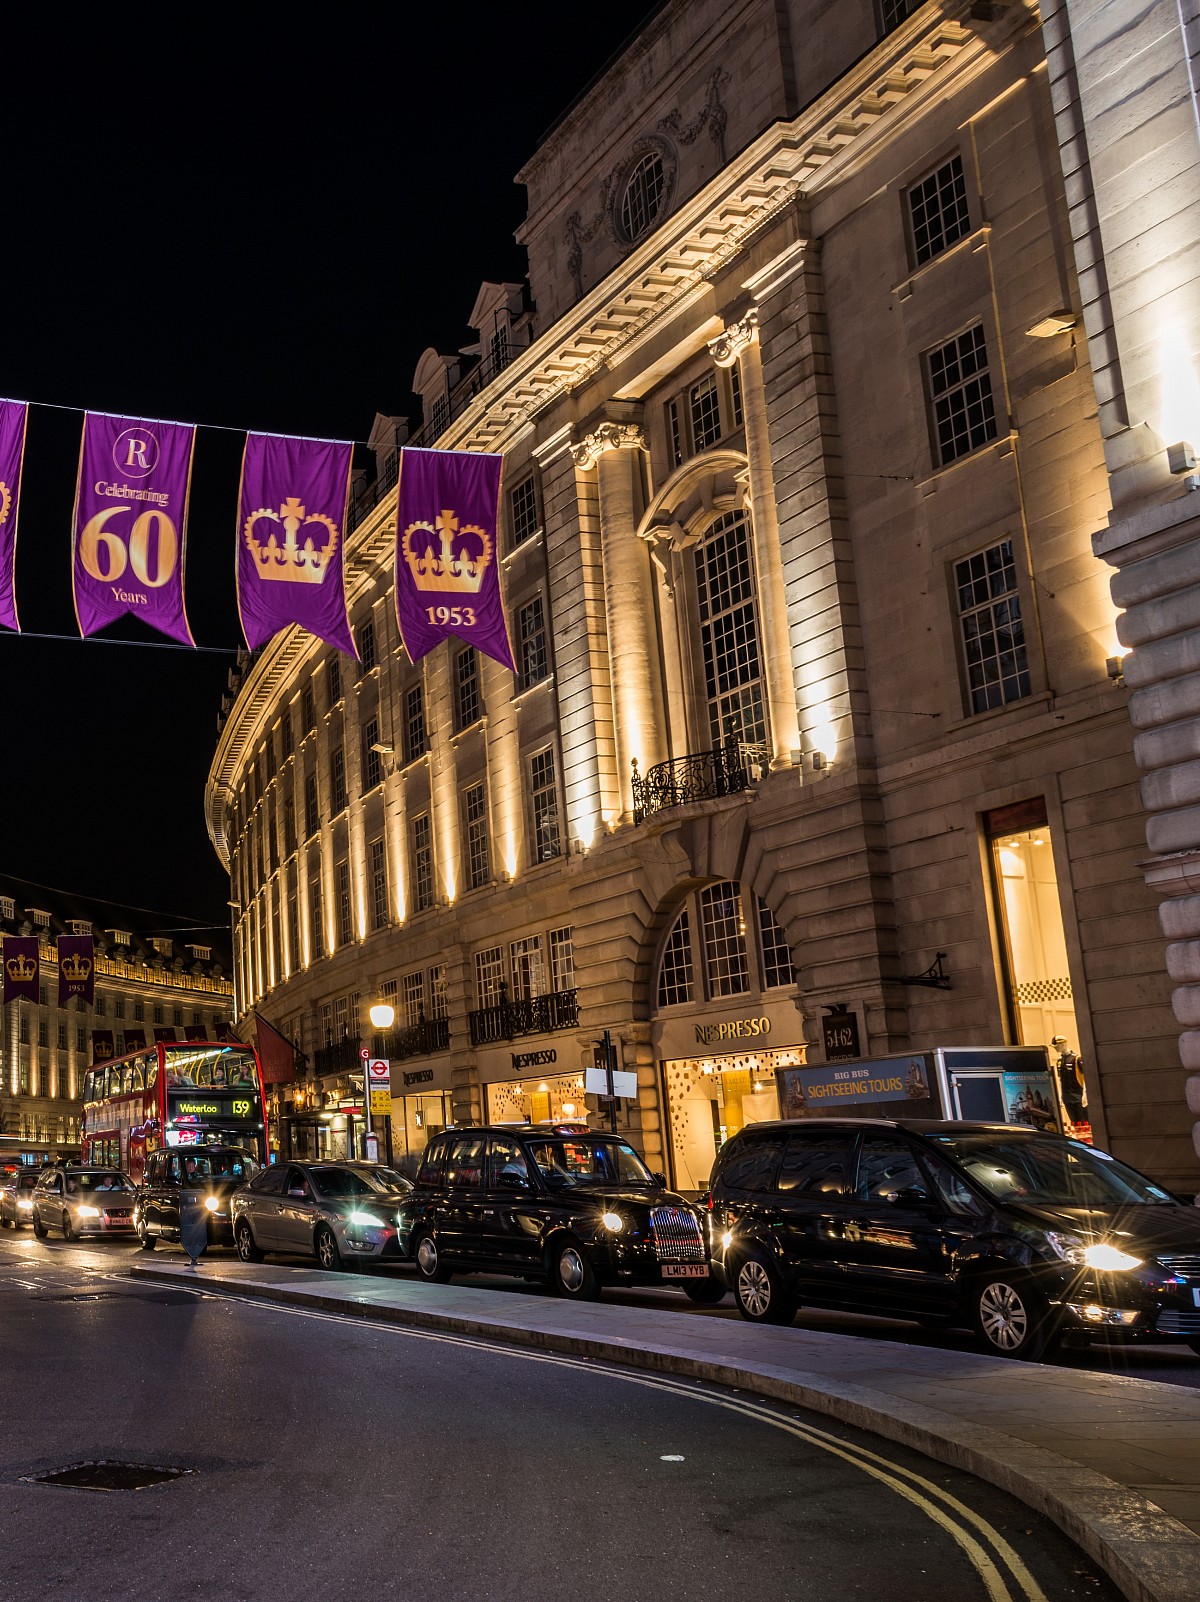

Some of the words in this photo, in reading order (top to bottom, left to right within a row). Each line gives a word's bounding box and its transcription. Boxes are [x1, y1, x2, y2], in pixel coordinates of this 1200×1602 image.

[95, 480, 169, 507] Celebrating
[80, 506, 178, 589] 60
[111, 586, 148, 606] Years
[426, 606, 478, 628] 1953
[68, 984, 85, 992] 1953
[692, 1016, 772, 1046] NESPRESSO
[361, 1049, 369, 1058] G
[511, 1049, 557, 1071] NESPRESSO
[402, 1069, 433, 1087] NESPRESSO
[834, 1072, 850, 1080] BIG
[851, 1070, 869, 1078] BUS
[808, 1081, 867, 1099] SIGHTSEEING
[868, 1077, 903, 1094] TOURS
[180, 1104, 217, 1113] Waterloo
[232, 1101, 250, 1114] 139
[666, 1265, 687, 1276] LM13
[689, 1265, 705, 1275] YYB
